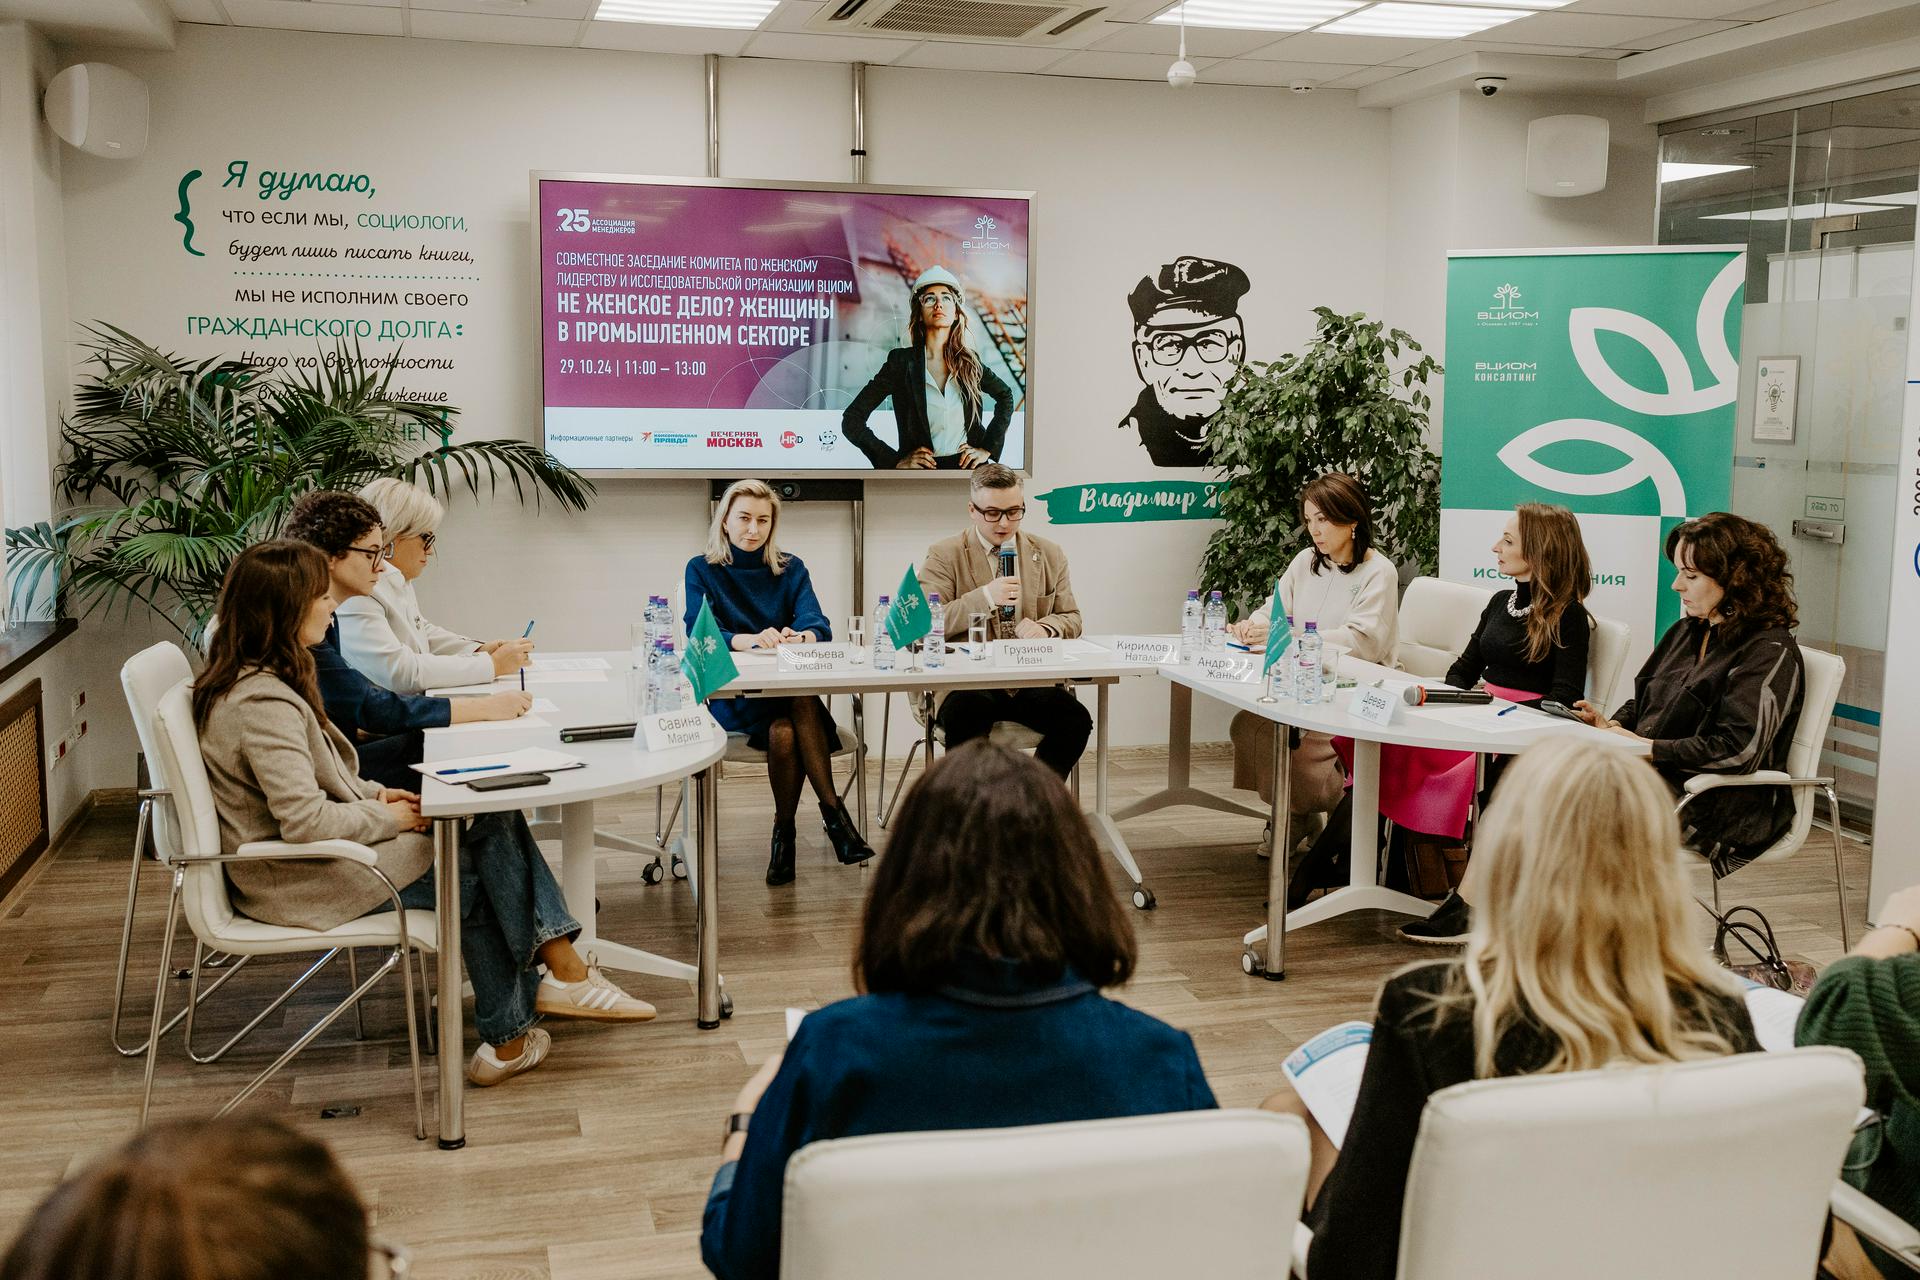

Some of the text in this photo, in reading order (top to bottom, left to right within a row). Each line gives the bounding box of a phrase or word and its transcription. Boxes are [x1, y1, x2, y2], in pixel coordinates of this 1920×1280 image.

[222, 160, 376, 200] Я думаю,
[222, 210, 255, 224] что
[261, 211, 307, 225] если
[313, 213, 348, 230] мы,
[556, 208, 591, 233] 25
[592, 219, 636, 227] АССОЦИАЦИЯ
[592, 226, 636, 234] МЕНЕДЖЕРОВ
[228, 239, 475, 264] будем лишь писать книги,
[962, 241, 1010, 249] ВЦИОМ
[556, 252, 819, 273] СОВМЕСТНОЕ ЗАСЕДАНИЕ КОМИТЕТА ПО ЖЕНСКОМУ
[556, 273, 853, 294] ЛИДЕРСТВУ И ИССЛЕДОВАТЕЛЬСКОЙ ОРГАНИЗАЦИИ ВЦИОМ
[235, 288, 468, 307] мы не исполним своего
[557, 293, 834, 321] НЕ ЖЕНСКОЕ ДЕЛО? ЖЕНЩИНЫ
[1477, 311, 1539, 320] ВЦИОМ
[187, 317, 371, 339] ГРАЖДАНСКОГО
[557, 322, 810, 347] В ПРОМЫШЛЕННОМ СЕКТОРЕ
[240, 351, 288, 373] Надо
[296, 356, 317, 368] по
[560, 359, 612, 375] 29.10.24
[625, 360, 657, 376] 11:00
[675, 361, 707, 376] 13:00
[1475, 362, 1537, 371] ВЦИОМ
[706, 438, 763, 448] МОСКВА
[1079, 487, 1197, 517] Владимир
[1003, 644, 1054, 656] Грузинов
[1016, 655, 1043, 665] Иван
[658, 715, 702, 731] Савина
[667, 731, 701, 745] Мария
